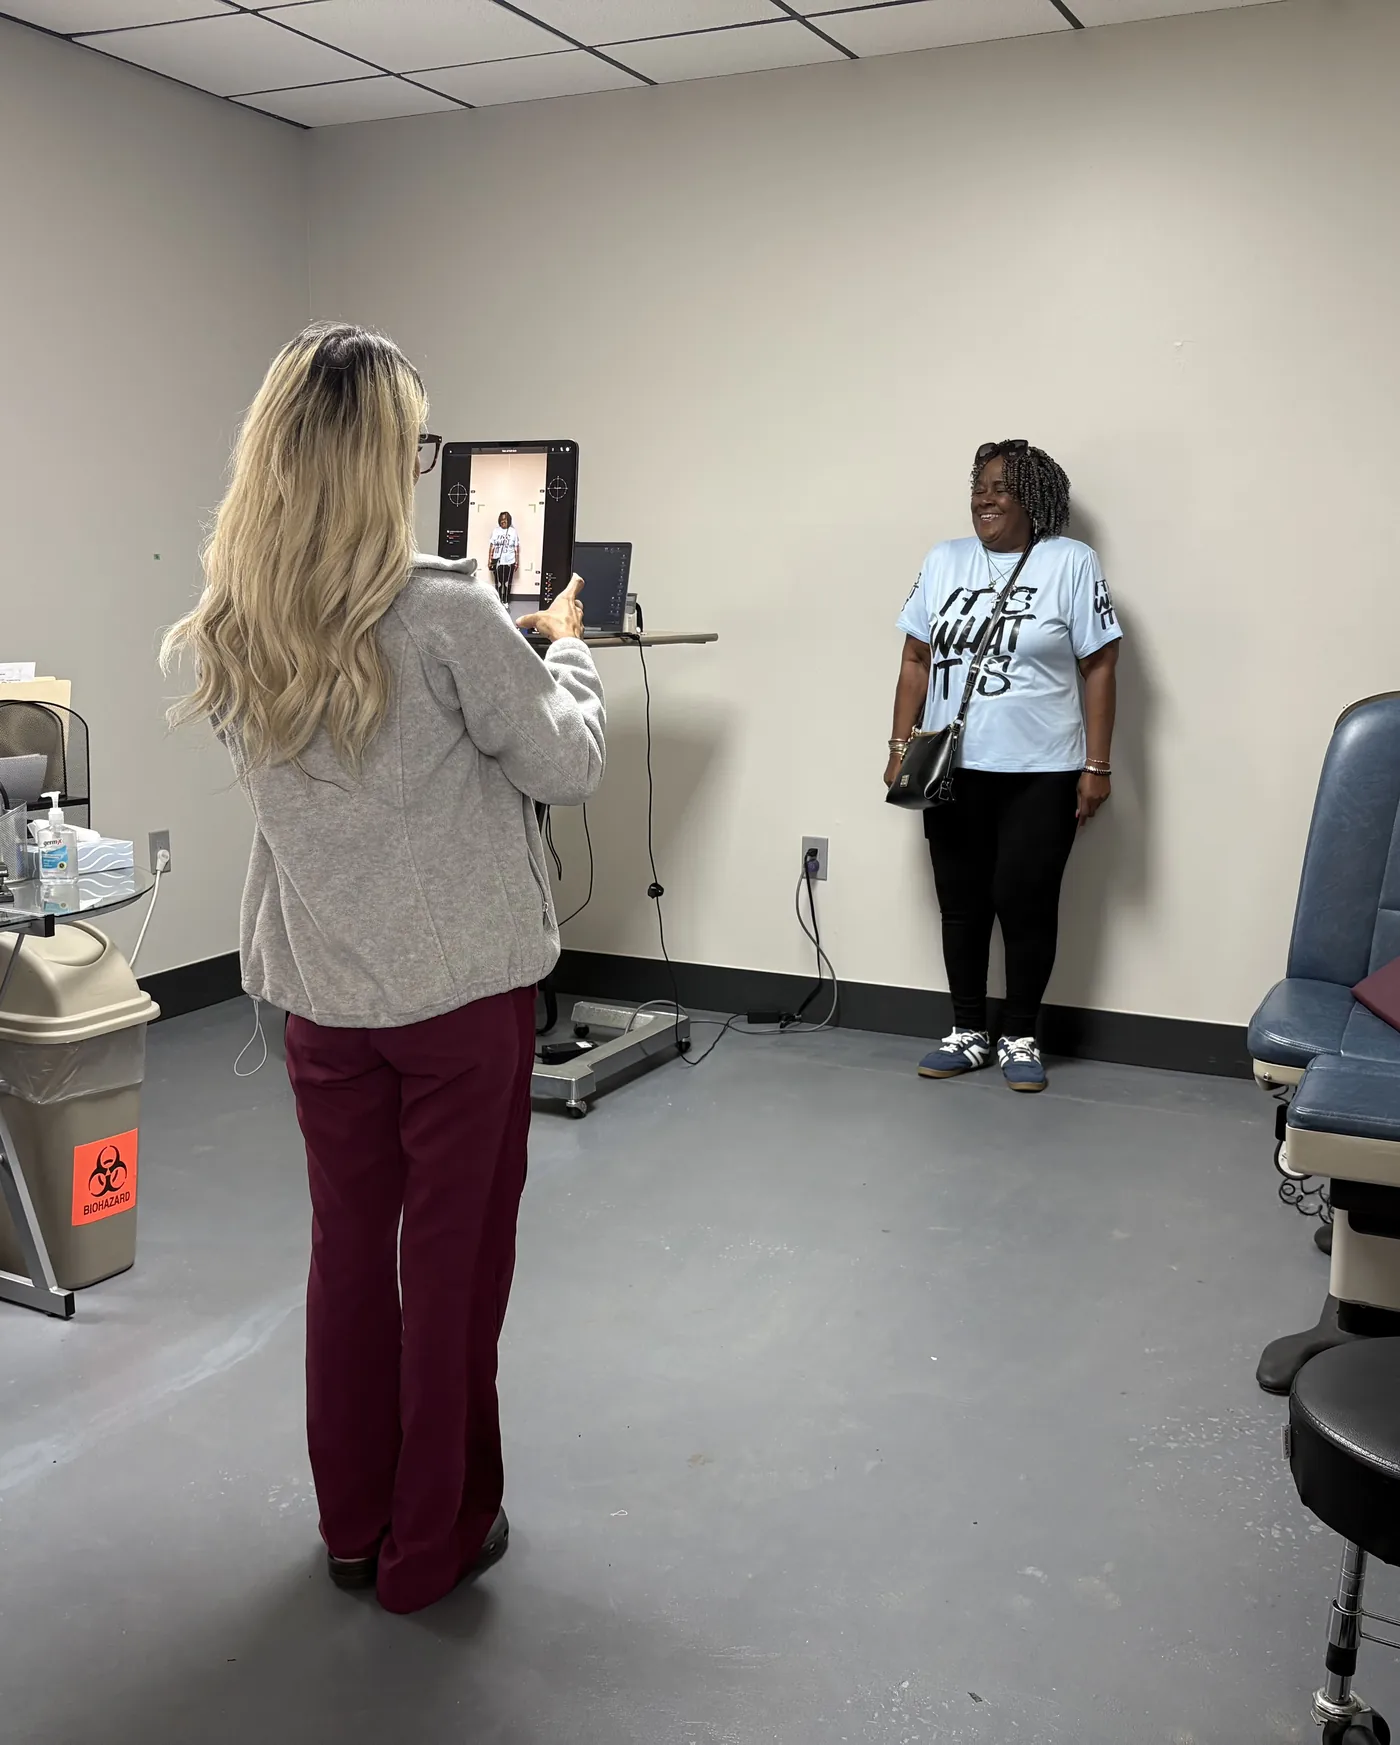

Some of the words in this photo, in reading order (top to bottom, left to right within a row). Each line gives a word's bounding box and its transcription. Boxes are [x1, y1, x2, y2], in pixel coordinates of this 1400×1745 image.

[939, 586, 996, 617] IT
[991, 586, 1038, 615] S
[929, 614, 1037, 659] WHAT
[932, 658, 963, 702] IT
[83, 1191, 131, 1216] BIOHAZARD
